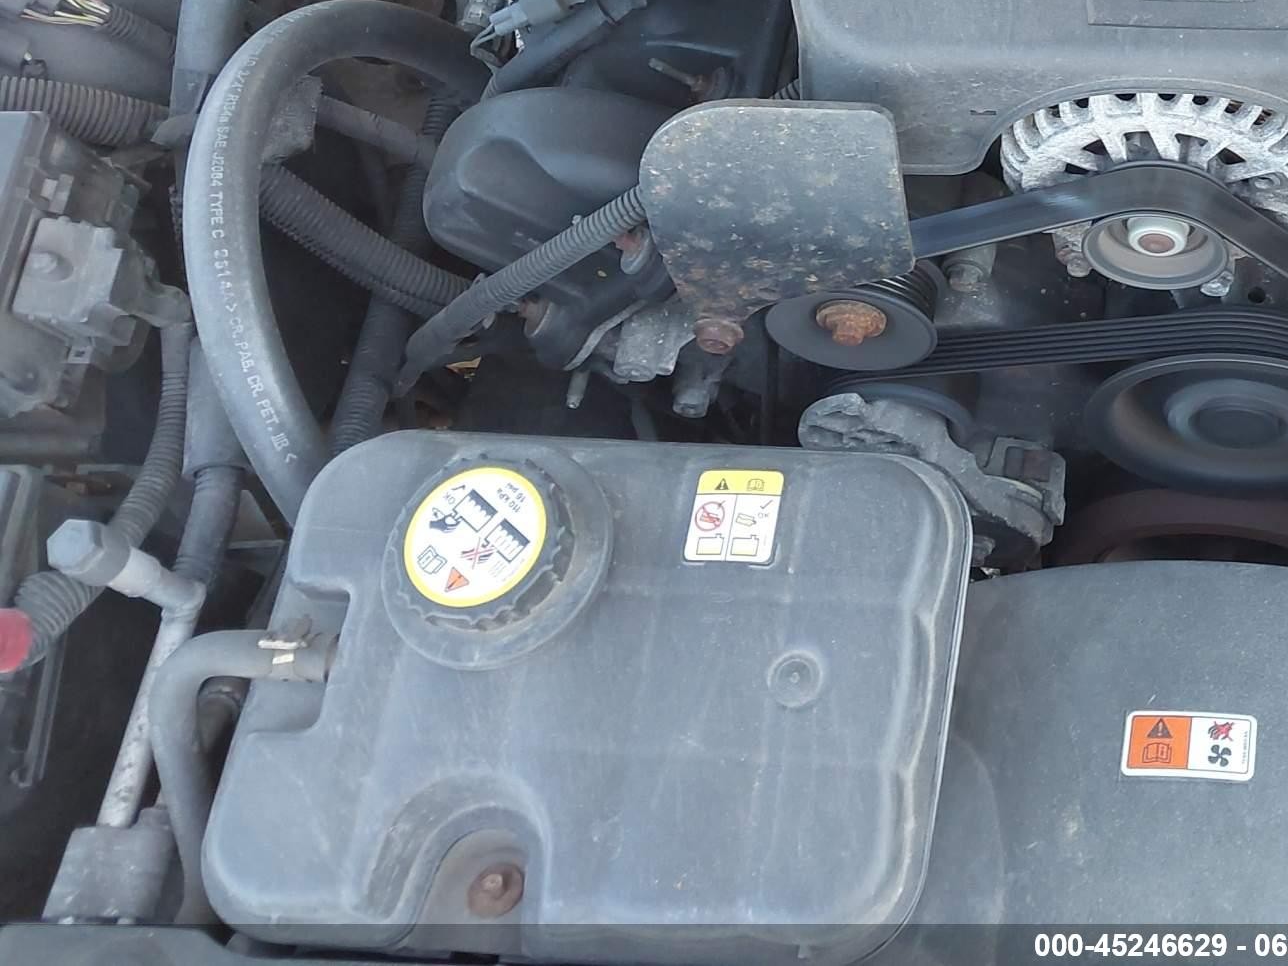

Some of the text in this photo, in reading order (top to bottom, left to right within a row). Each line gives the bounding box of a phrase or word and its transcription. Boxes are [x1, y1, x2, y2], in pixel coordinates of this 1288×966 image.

[214, 125, 230, 148] SAE
[209, 191, 224, 226] TYPE
[212, 229, 225, 239] C
